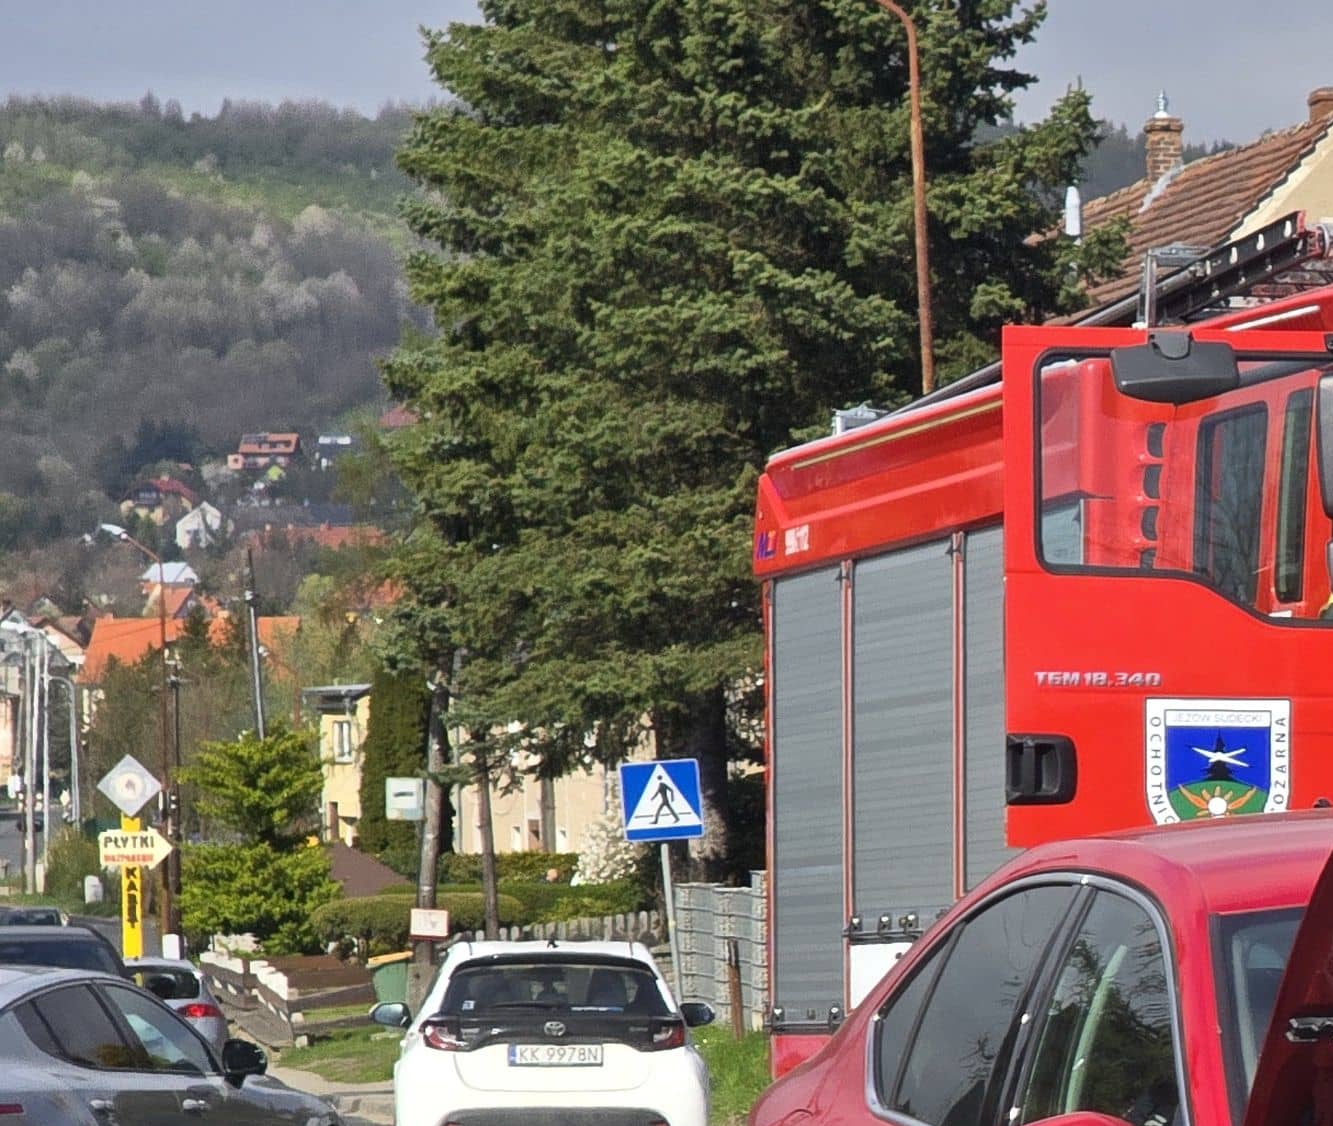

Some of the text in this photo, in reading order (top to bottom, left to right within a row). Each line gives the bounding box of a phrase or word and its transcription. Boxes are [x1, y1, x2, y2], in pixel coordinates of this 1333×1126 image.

[1034, 671, 1162, 687] TGM 18.340
[518, 1046, 598, 1062] KK 9978N
